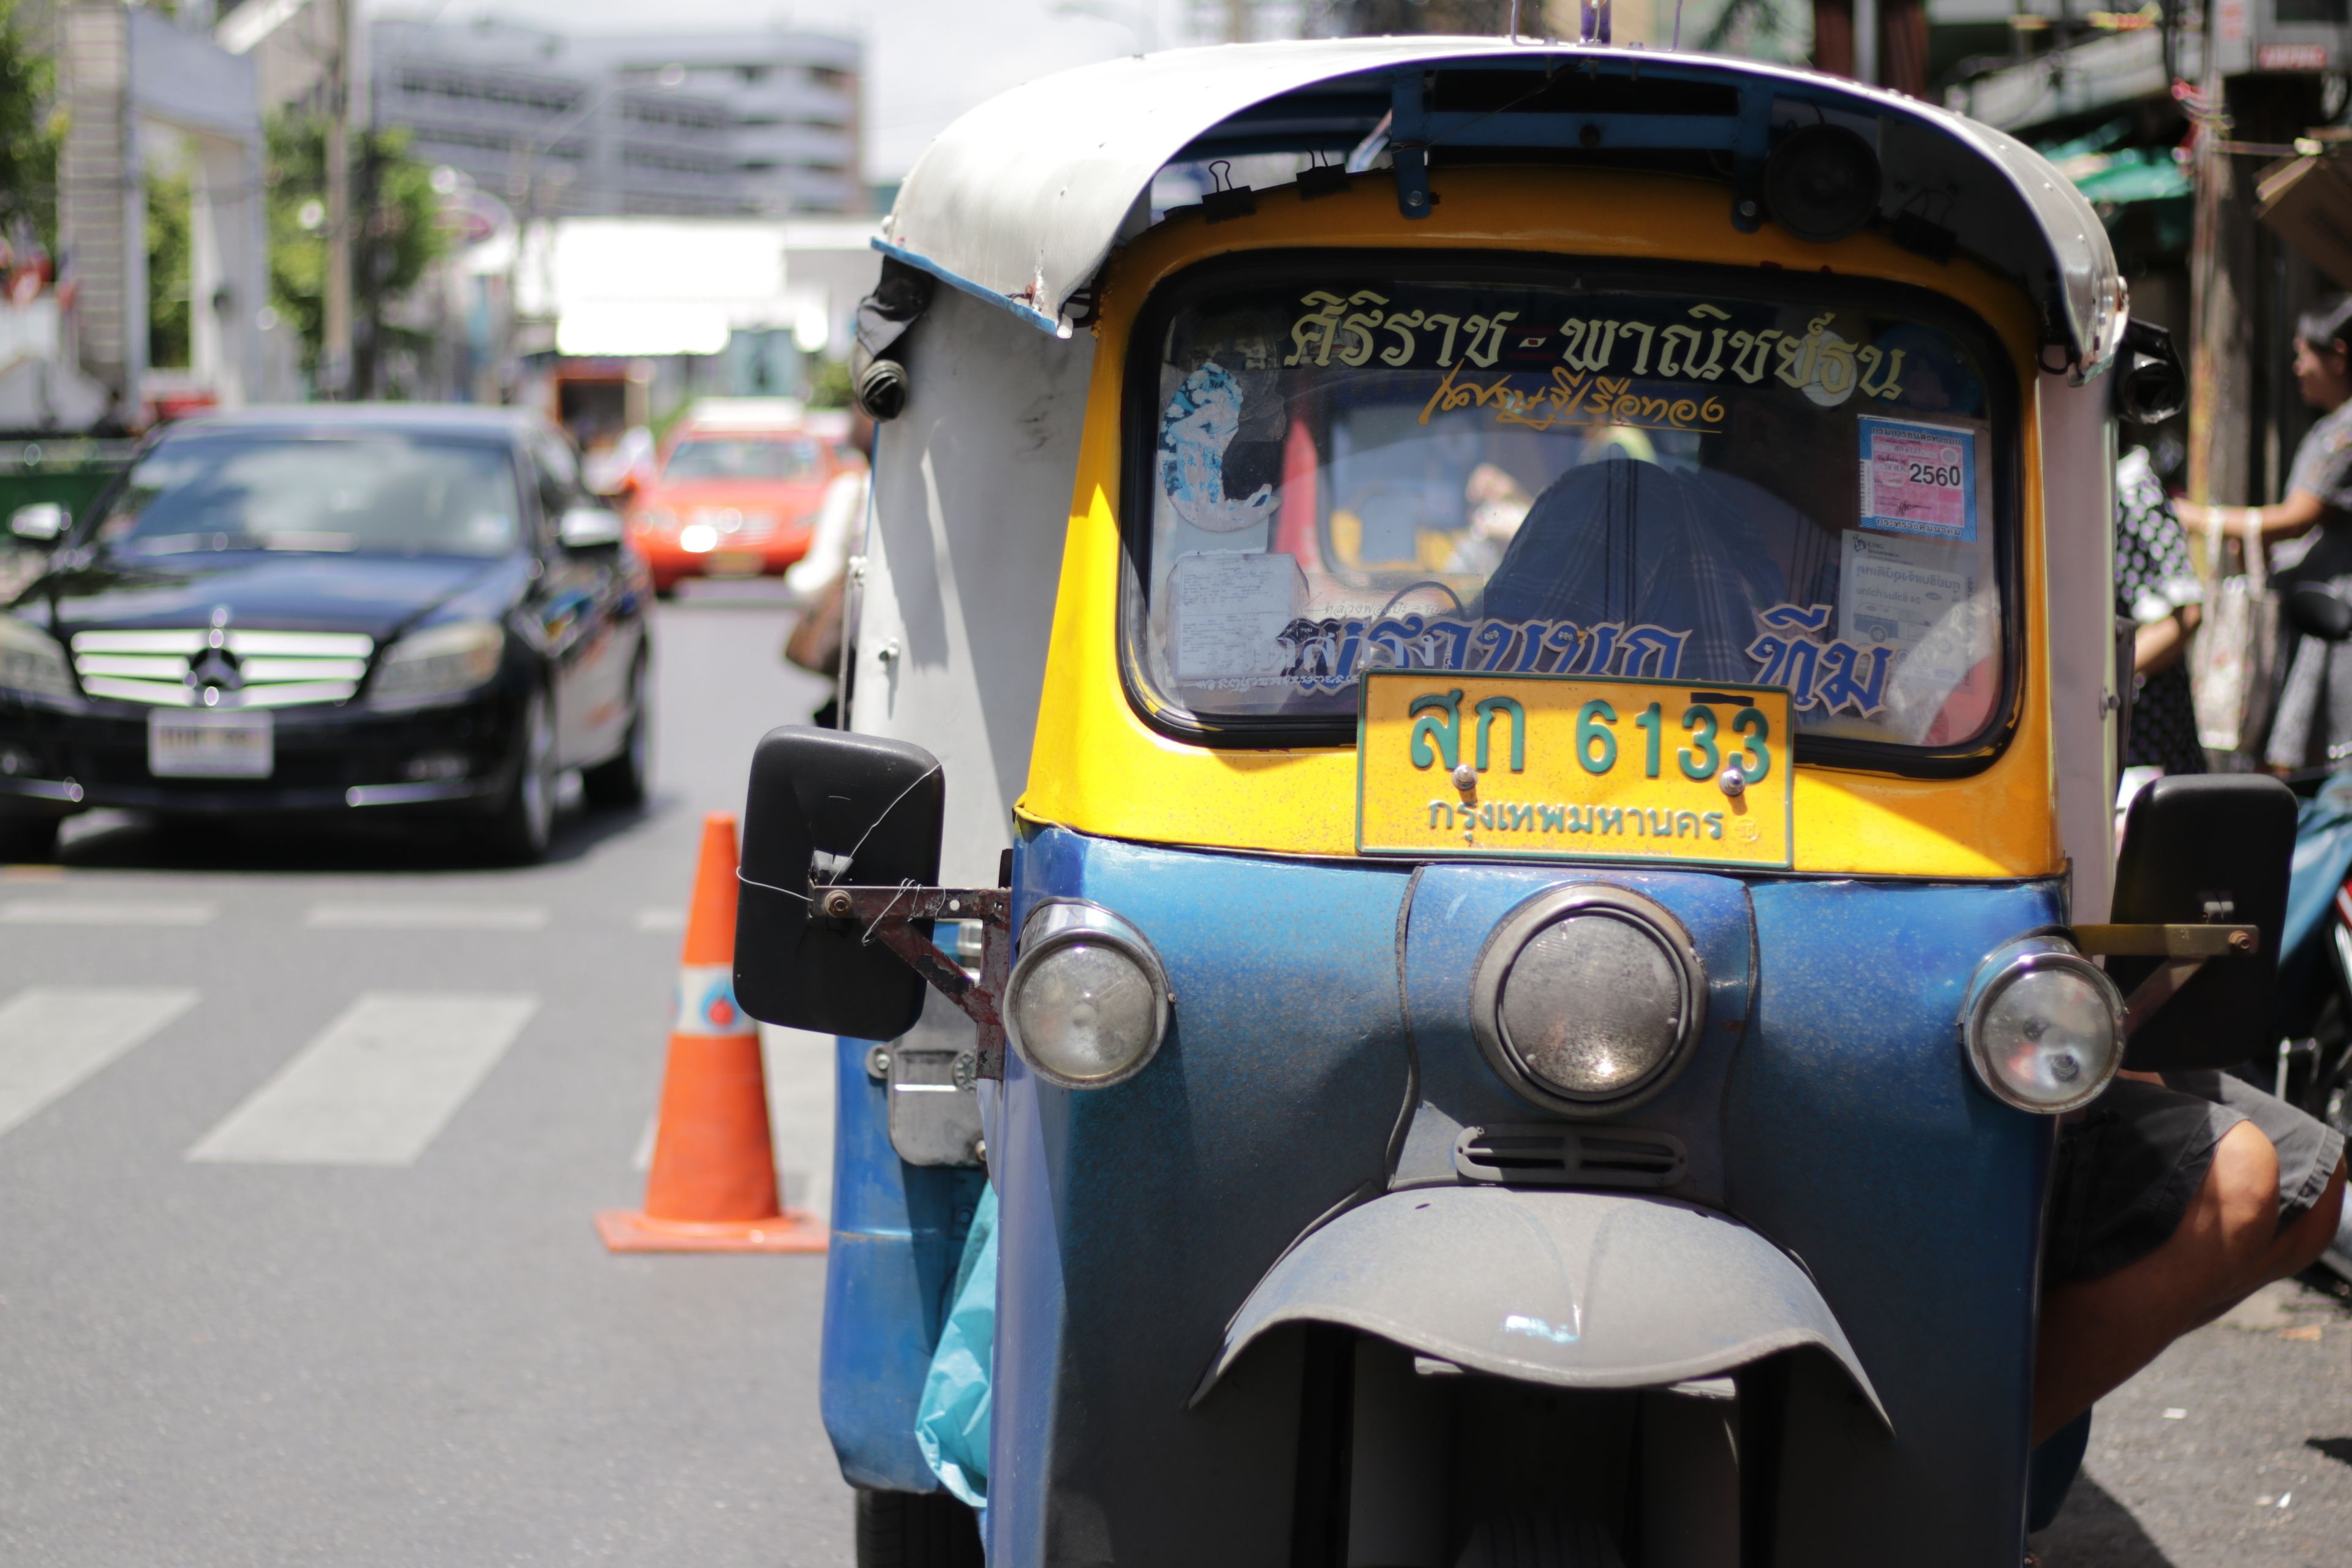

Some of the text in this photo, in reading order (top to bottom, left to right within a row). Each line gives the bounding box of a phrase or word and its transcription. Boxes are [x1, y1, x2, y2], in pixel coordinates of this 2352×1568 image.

[1284, 290, 1518, 369] ศิริราช
[1559, 303, 1906, 402] พาณิชย์ธน
[1909, 462, 1961, 487] 2560
[1744, 603, 1899, 719] ทีม
[1409, 688, 1771, 784] สก 6133
[1428, 800, 1725, 842] กรุงเทพมหานคร
